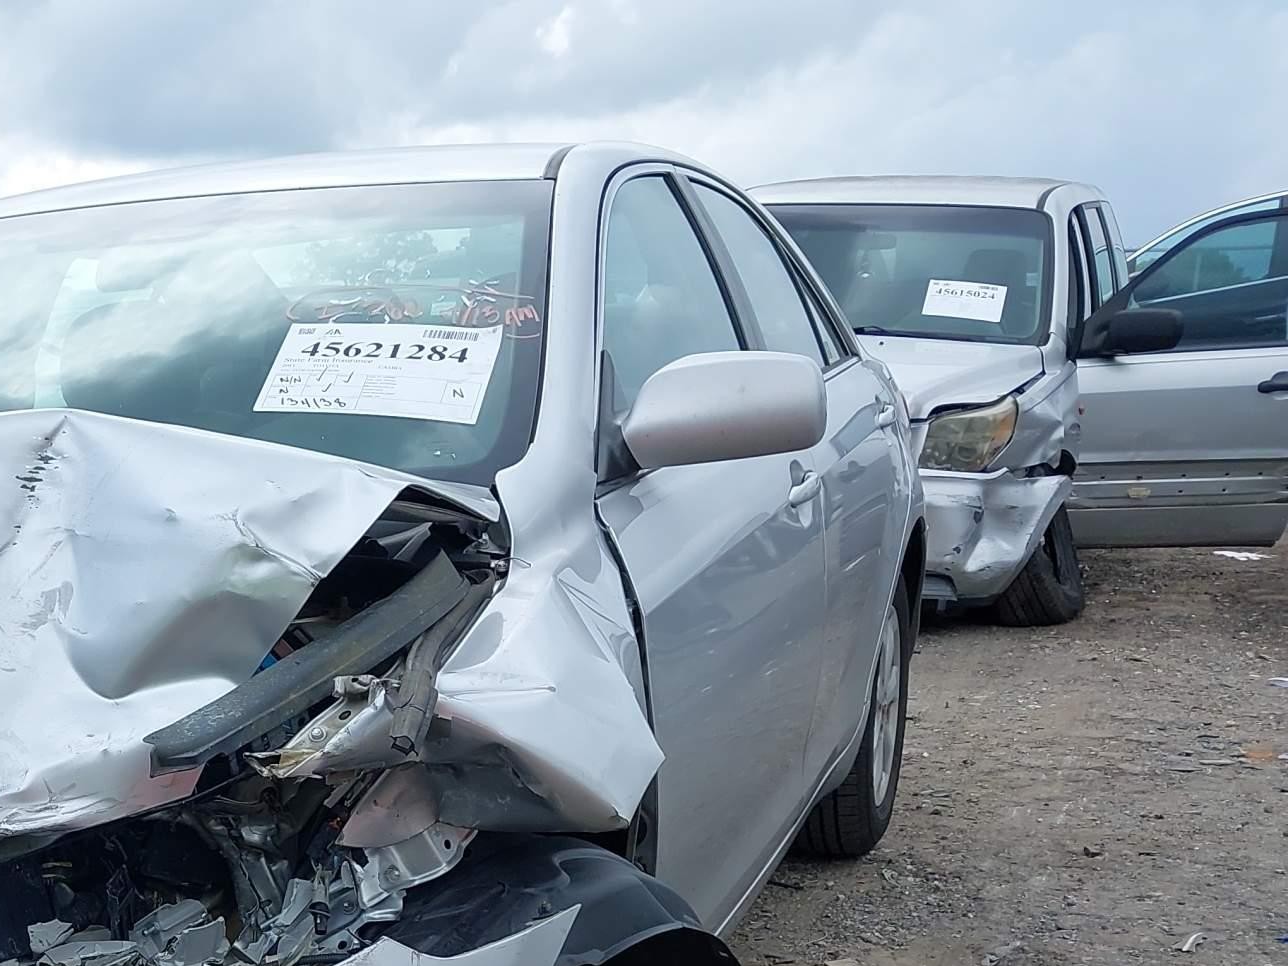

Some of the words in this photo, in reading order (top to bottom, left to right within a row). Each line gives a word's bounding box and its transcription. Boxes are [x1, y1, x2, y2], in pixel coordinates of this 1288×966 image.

[935, 288, 996, 300] 45615024
[300, 341, 470, 364] 45621284
[452, 387, 465, 399] N
